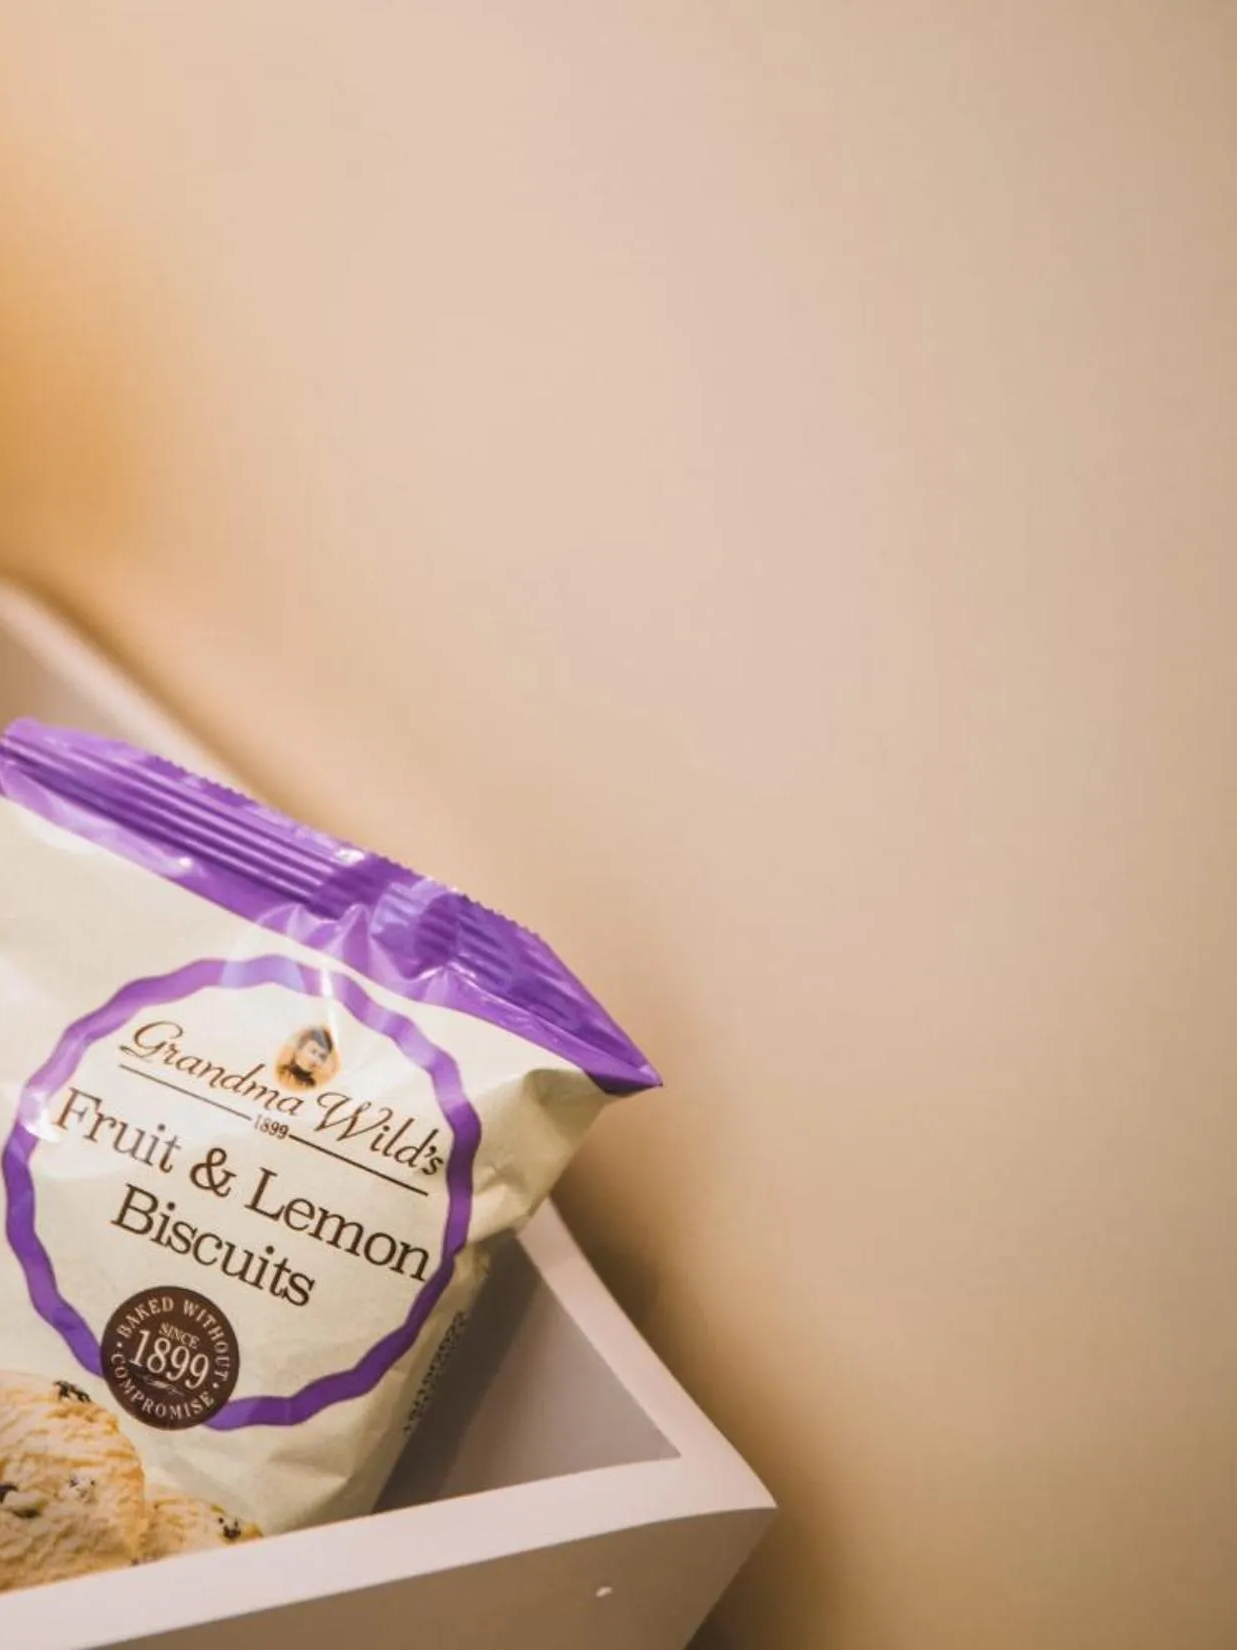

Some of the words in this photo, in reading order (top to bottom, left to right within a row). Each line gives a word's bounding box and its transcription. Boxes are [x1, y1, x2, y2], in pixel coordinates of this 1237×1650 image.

[119, 1020, 303, 1117] Grandma
[316, 1090, 444, 1176] Wild's
[254, 1114, 290, 1140] 1899
[52, 1086, 182, 1175] Fruit
[189, 1146, 238, 1199] &
[244, 1166, 431, 1282] Lemon
[110, 1183, 317, 1307] Biscuits
[116, 1296, 175, 1339] BAKED
[182, 1298, 231, 1382] WITHOUT
[129, 1329, 210, 1390] 1899
[158, 1322, 200, 1350] SINCE
[111, 1353, 215, 1420] COMPROMISE
